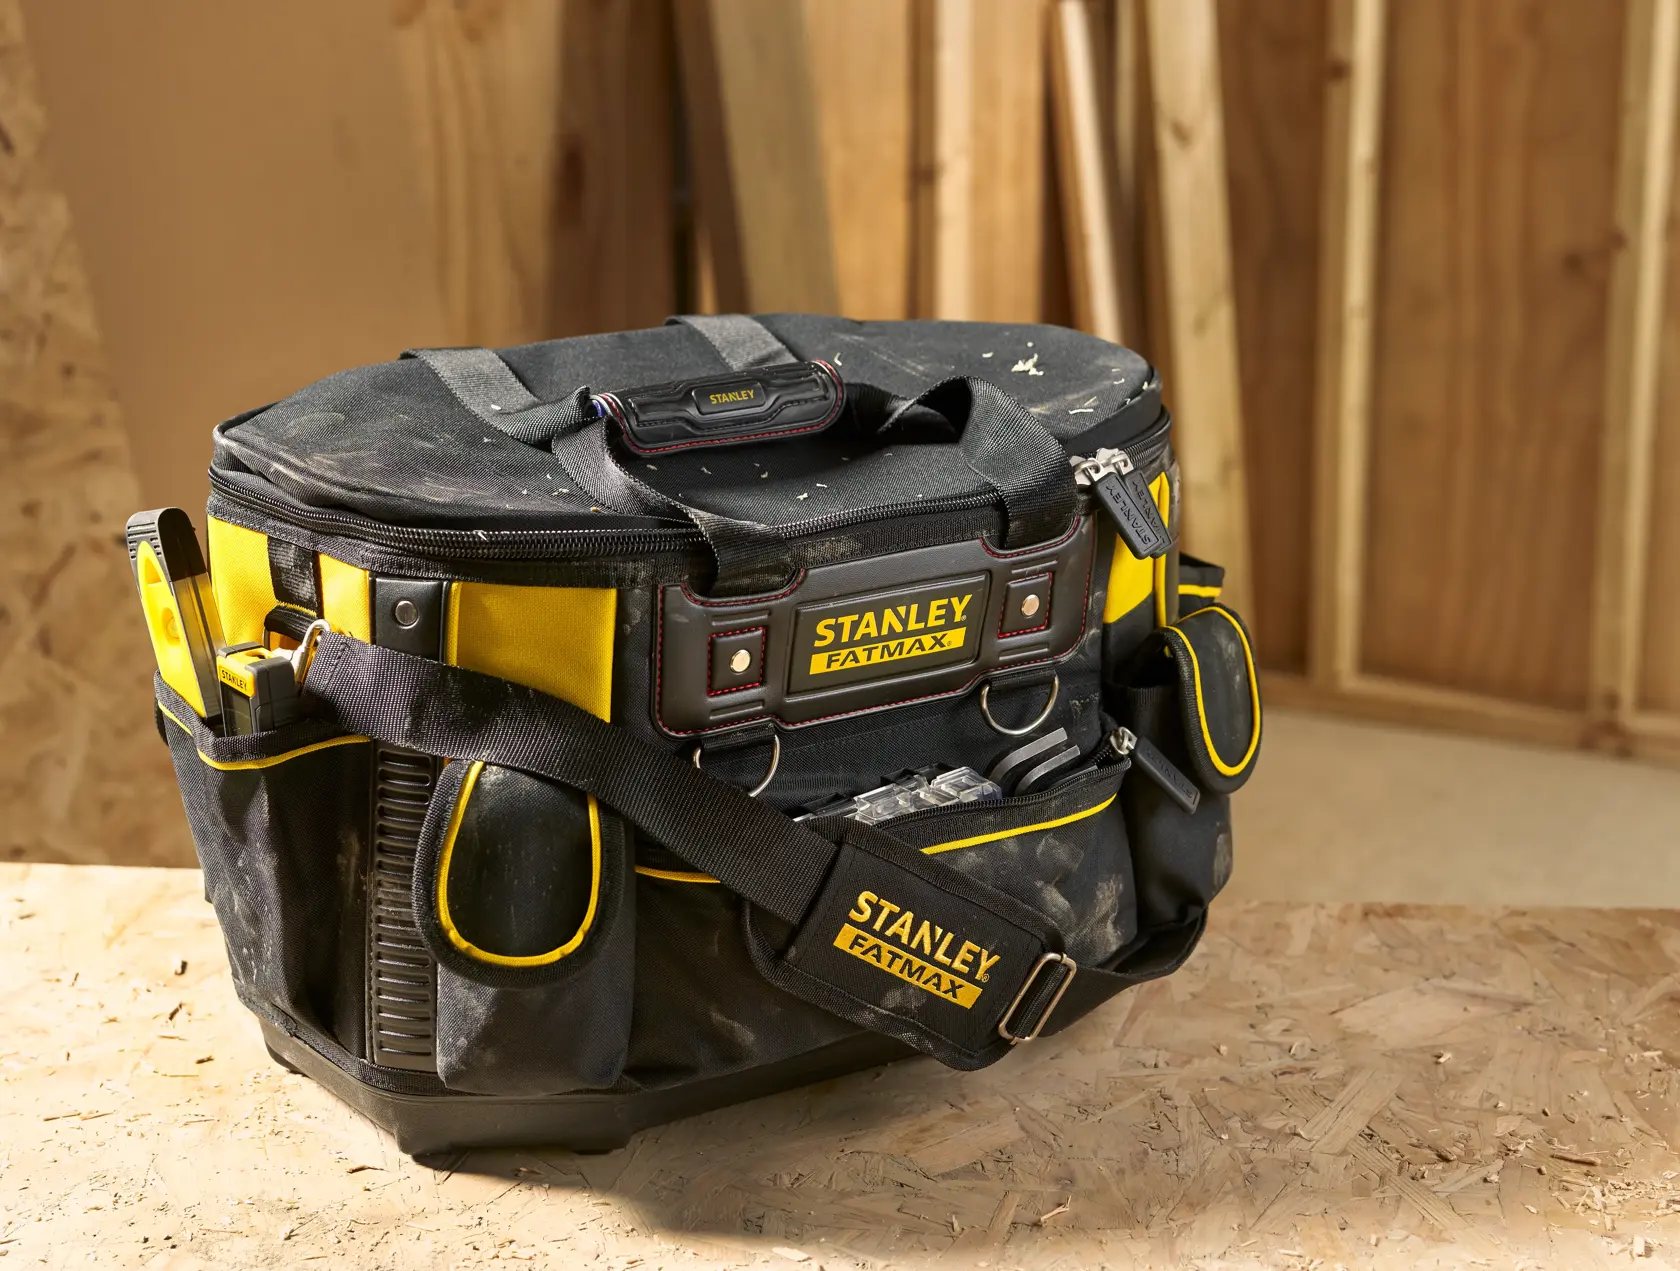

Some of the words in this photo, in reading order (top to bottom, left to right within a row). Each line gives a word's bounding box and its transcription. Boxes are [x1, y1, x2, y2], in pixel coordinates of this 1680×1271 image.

[709, 389, 754, 405] STANLEY
[1105, 484, 1151, 545] STANLEY
[1132, 480, 1165, 544] ANLEY
[813, 593, 973, 647] STANLEY
[826, 632, 949, 669] FATMAX
[221, 669, 248, 691] STANLEY
[848, 890, 1001, 982] STANLEY
[849, 933, 964, 1000] FATMAX
